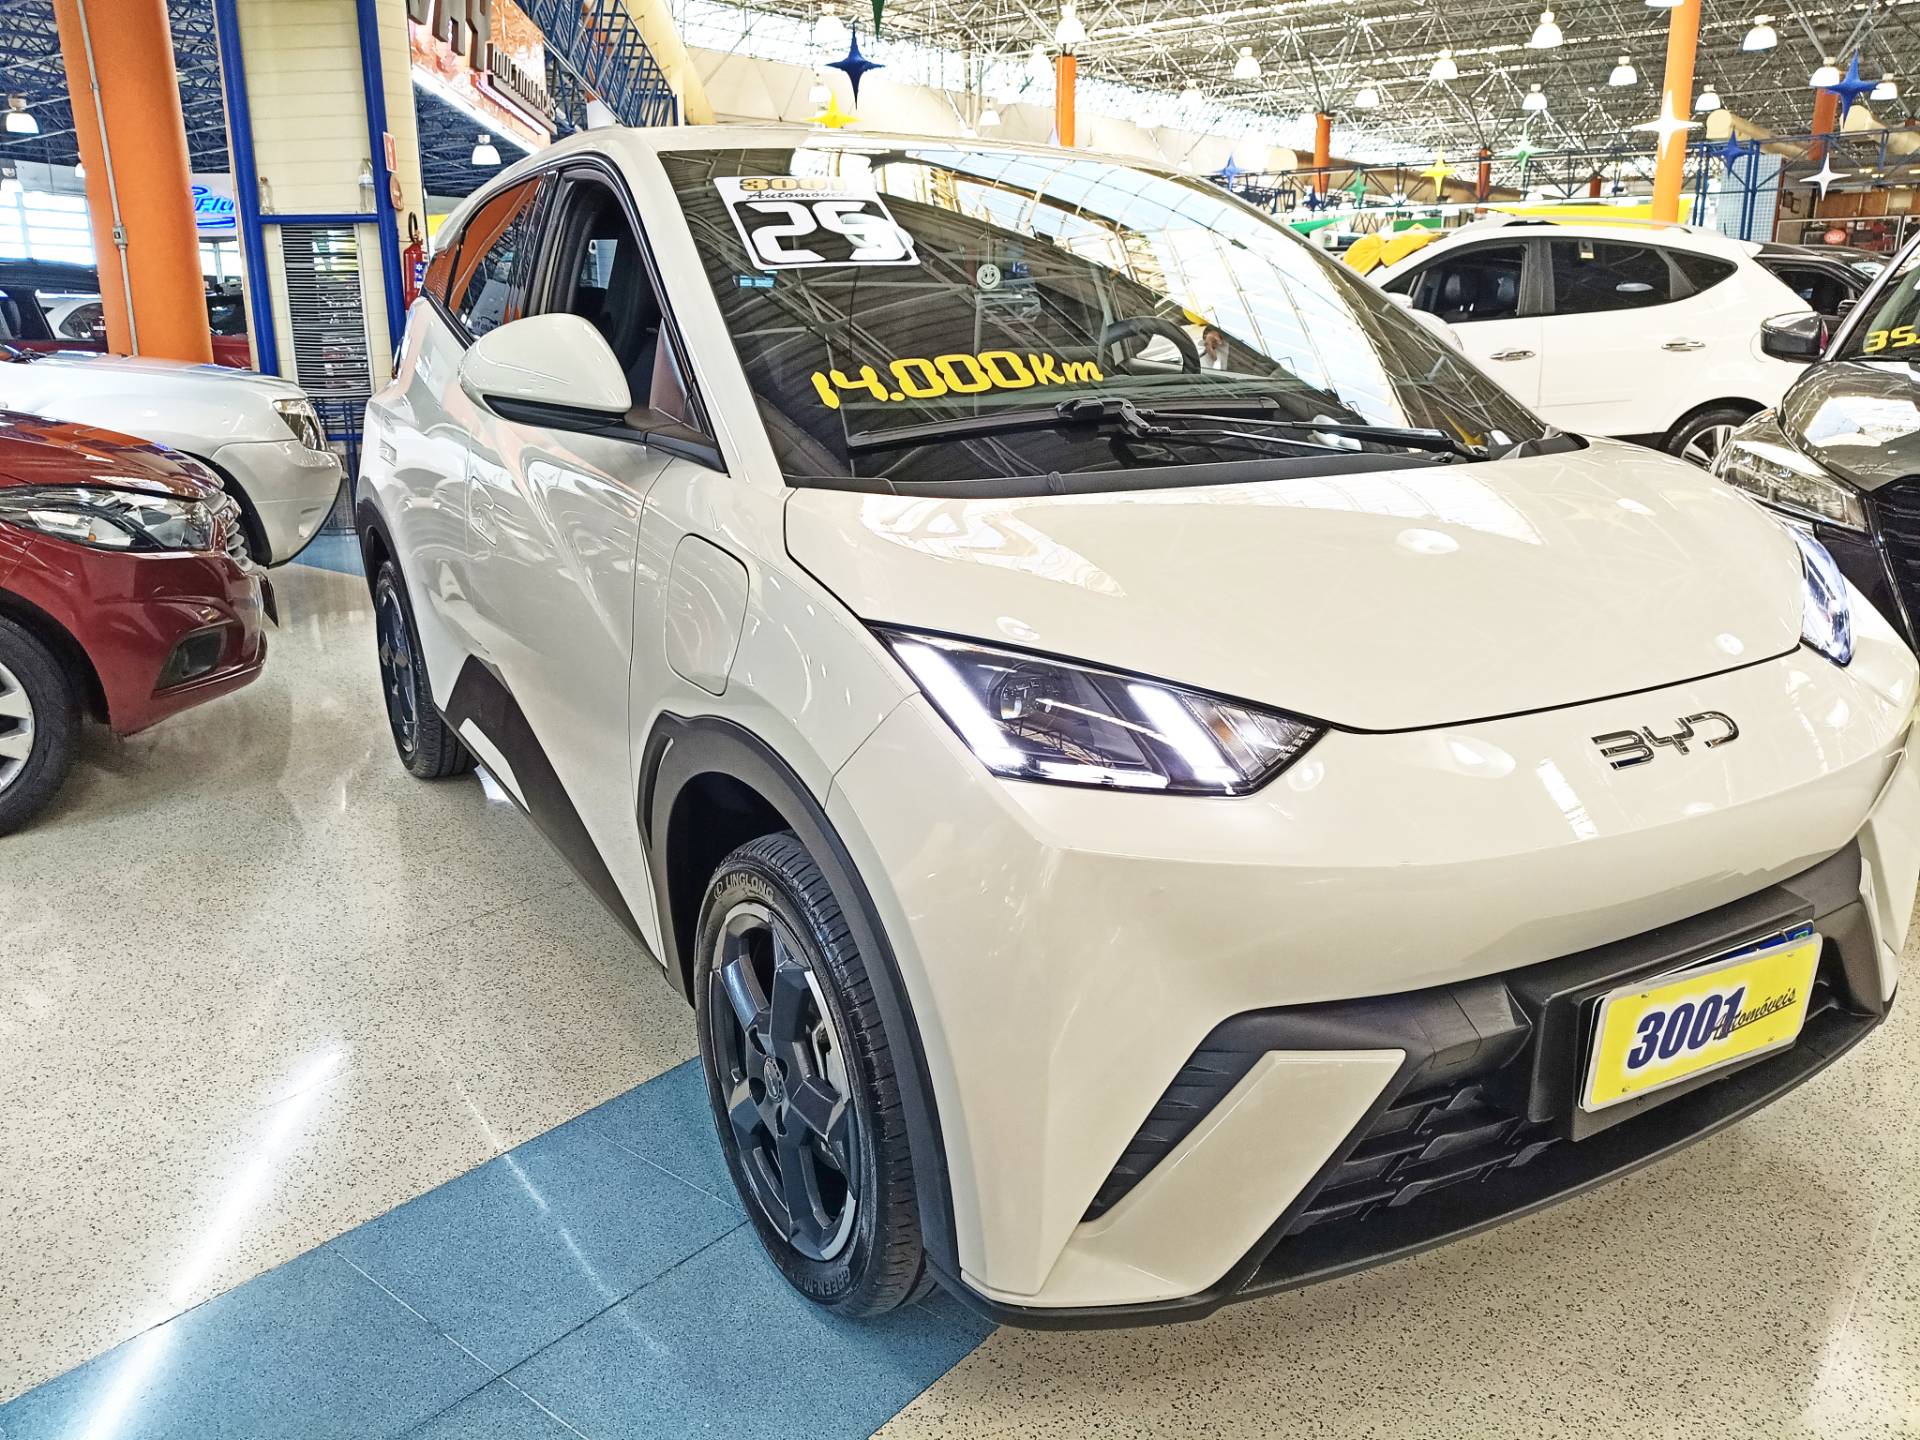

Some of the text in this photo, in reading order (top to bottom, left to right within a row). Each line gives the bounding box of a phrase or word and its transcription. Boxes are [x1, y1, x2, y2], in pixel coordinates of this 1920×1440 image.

[745, 201, 908, 264] 25
[1591, 711, 1740, 770] BYD
[725, 872, 775, 903] LINGLONG
[1627, 987, 1745, 1069] 3001
[1712, 988, 1796, 1040] Automóveis
